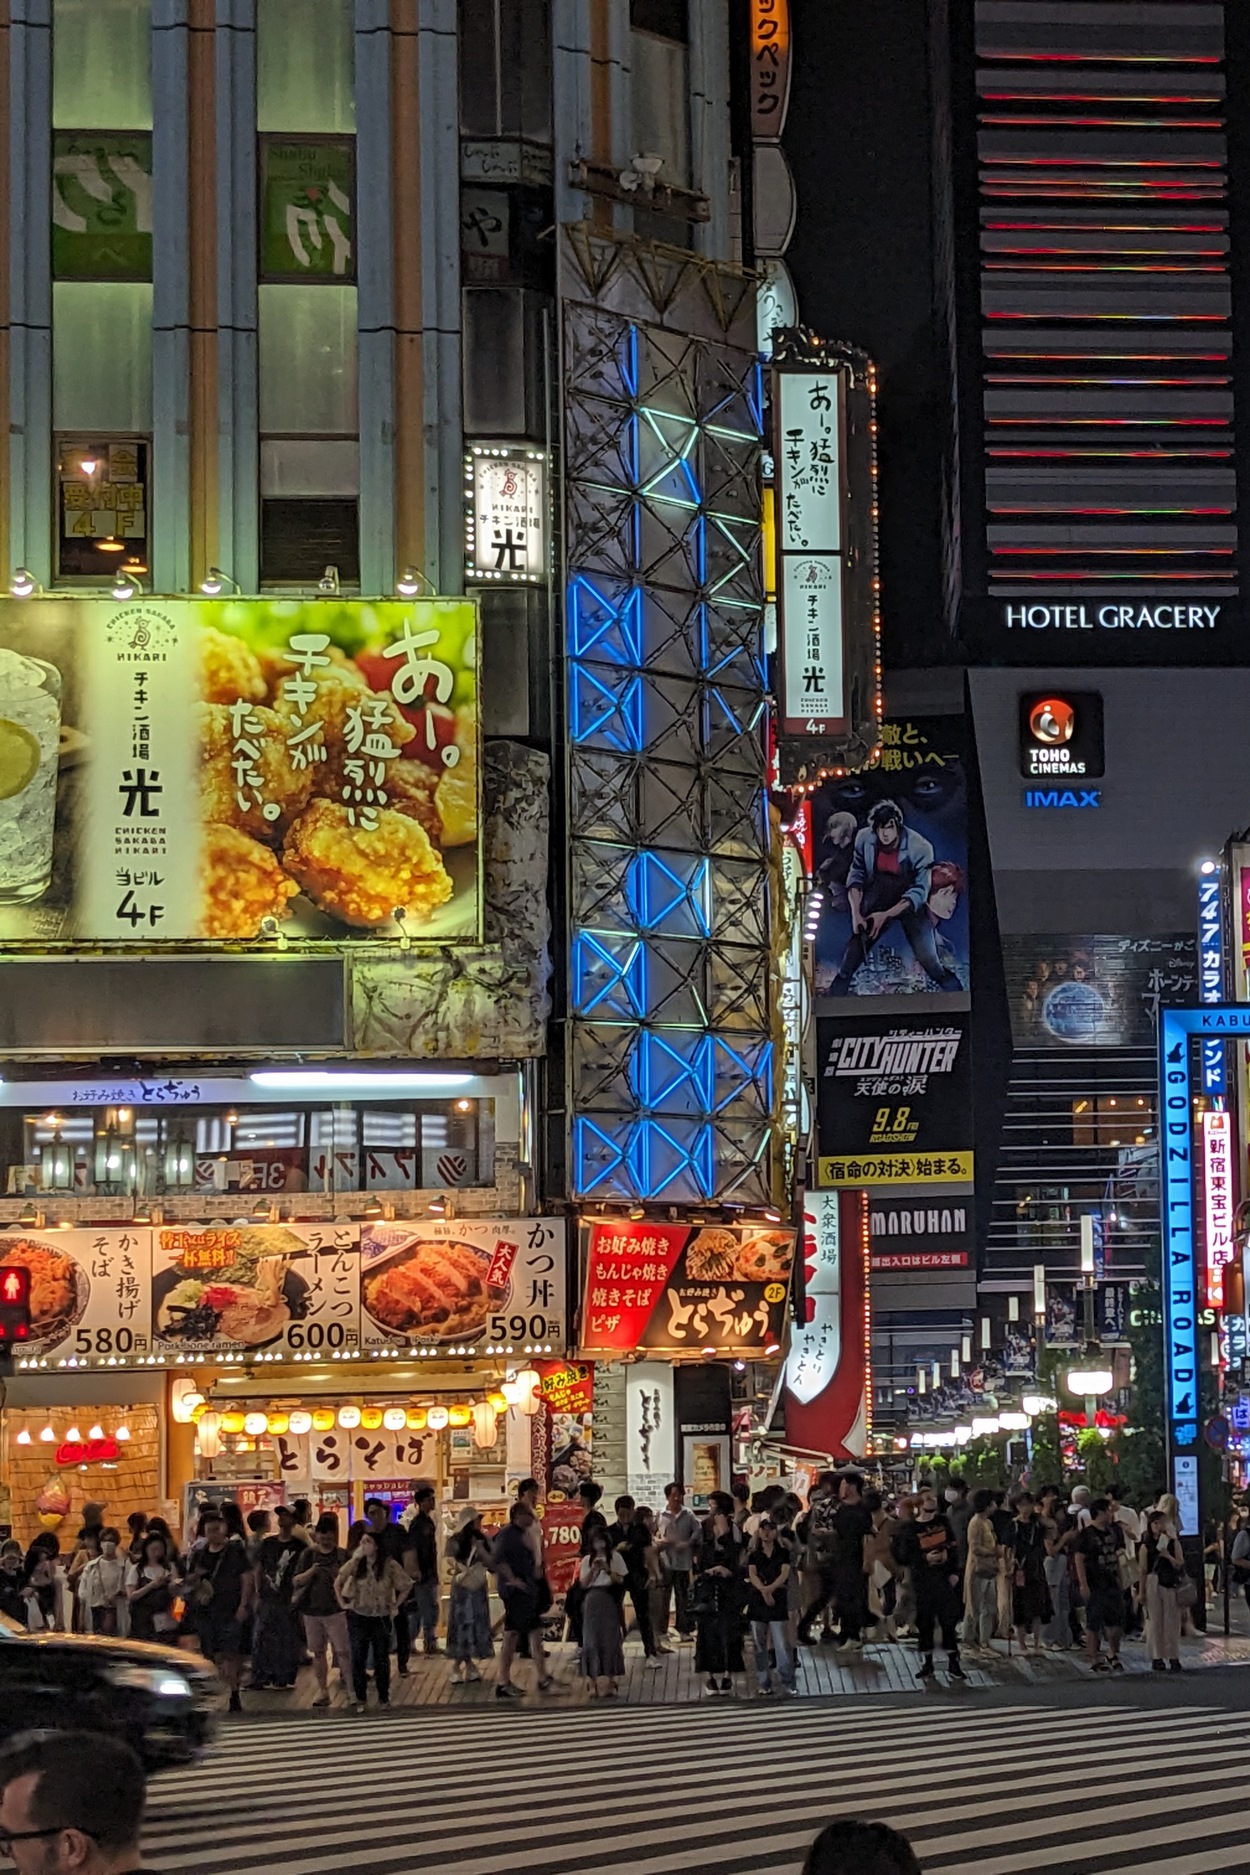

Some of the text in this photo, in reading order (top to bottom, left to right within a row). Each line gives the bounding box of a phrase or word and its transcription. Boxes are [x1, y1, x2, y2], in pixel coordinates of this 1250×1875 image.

[491, 529, 527, 571] 光
[1006, 605, 1221, 628] HOTEL GRACERY
[117, 652, 167, 662] HIKARI
[802, 666, 826, 693] 光
[132, 672, 150, 761] チキン酒場
[283, 634, 332, 772] チキンが
[806, 719, 826, 735] 4F
[342, 700, 402, 830] 猛烈に
[1030, 749, 1070, 762] TOHO
[1030, 763, 1086, 774] CINEMAS
[119, 768, 163, 818] 光
[1025, 791, 1099, 808] IMAX
[115, 867, 165, 887] 当ビル
[116, 890, 165, 928] 4F
[1201, 883, 1219, 943] 747
[821, 1196, 838, 1265] 大衆酒場
[871, 1209, 966, 1235] MARUHAN
[1167, 1071, 1194, 1382] GODZILLA ROAD
[91, 1236, 114, 1278] そば
[491, 1245, 512, 1285] 大人気
[596, 1236, 670, 1256] お好み焼き
[116, 1233, 141, 1321] かき揚げ
[307, 1232, 327, 1317] ラーメン
[331, 1230, 354, 1317] とんこつ
[525, 1223, 555, 1309] かつ丼
[595, 1264, 668, 1281] もんじゃ焼き
[591, 1287, 652, 1307] 焼きそば
[768, 1287, 782, 1299] 2F
[591, 1314, 621, 1333] ピザ
[278, 1432, 432, 1471] とらそば
